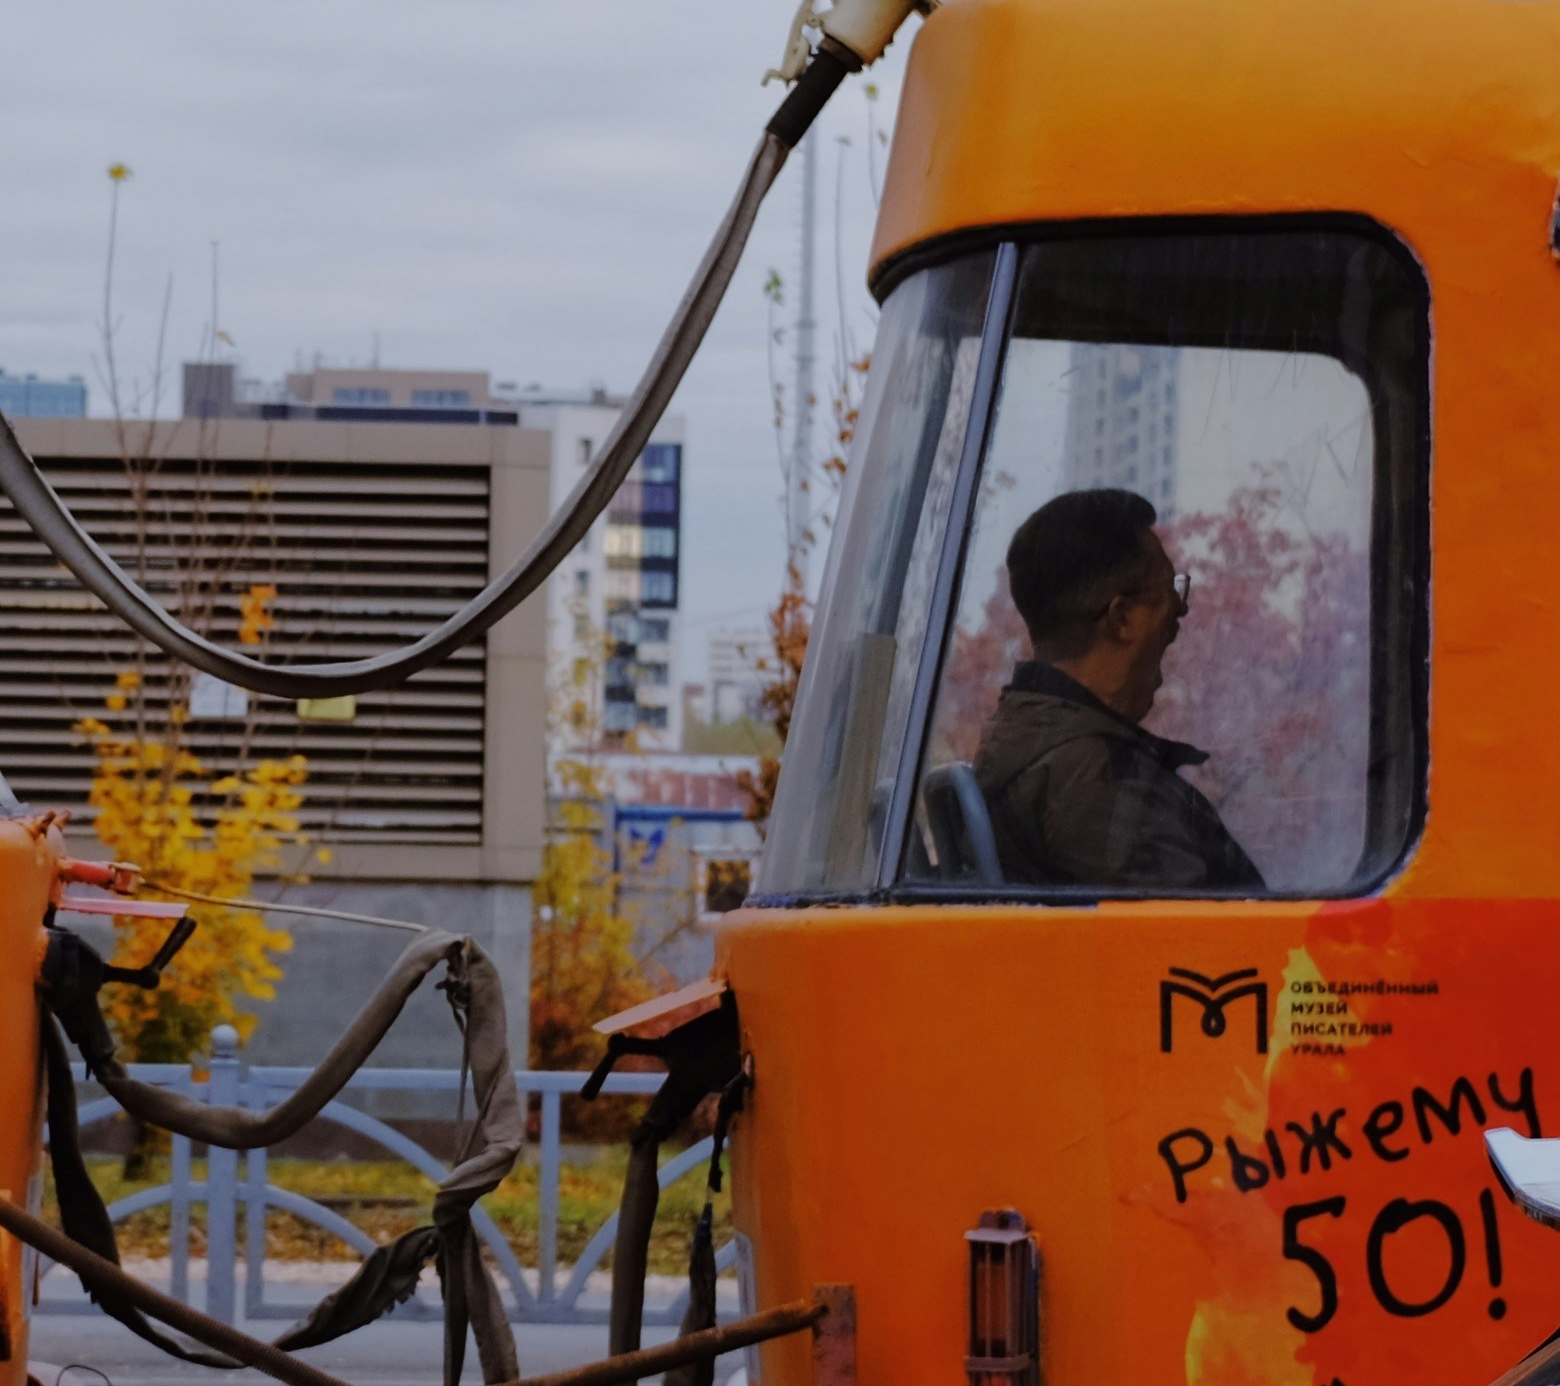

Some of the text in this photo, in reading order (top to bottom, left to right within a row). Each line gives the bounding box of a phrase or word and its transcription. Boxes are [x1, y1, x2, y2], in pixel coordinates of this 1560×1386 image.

[1290, 979, 1440, 996] ОБЪЕДИНЁННЫЙ
[1291, 1001, 1348, 1014] МУЗЕЙ
[1291, 1022, 1393, 1035] ПИСАТЕЛЕЙ
[1291, 1044, 1346, 1056] УРАЛА
[1158, 1067, 1542, 1204] Рыжему
[1282, 1187, 1507, 1334] 50!
